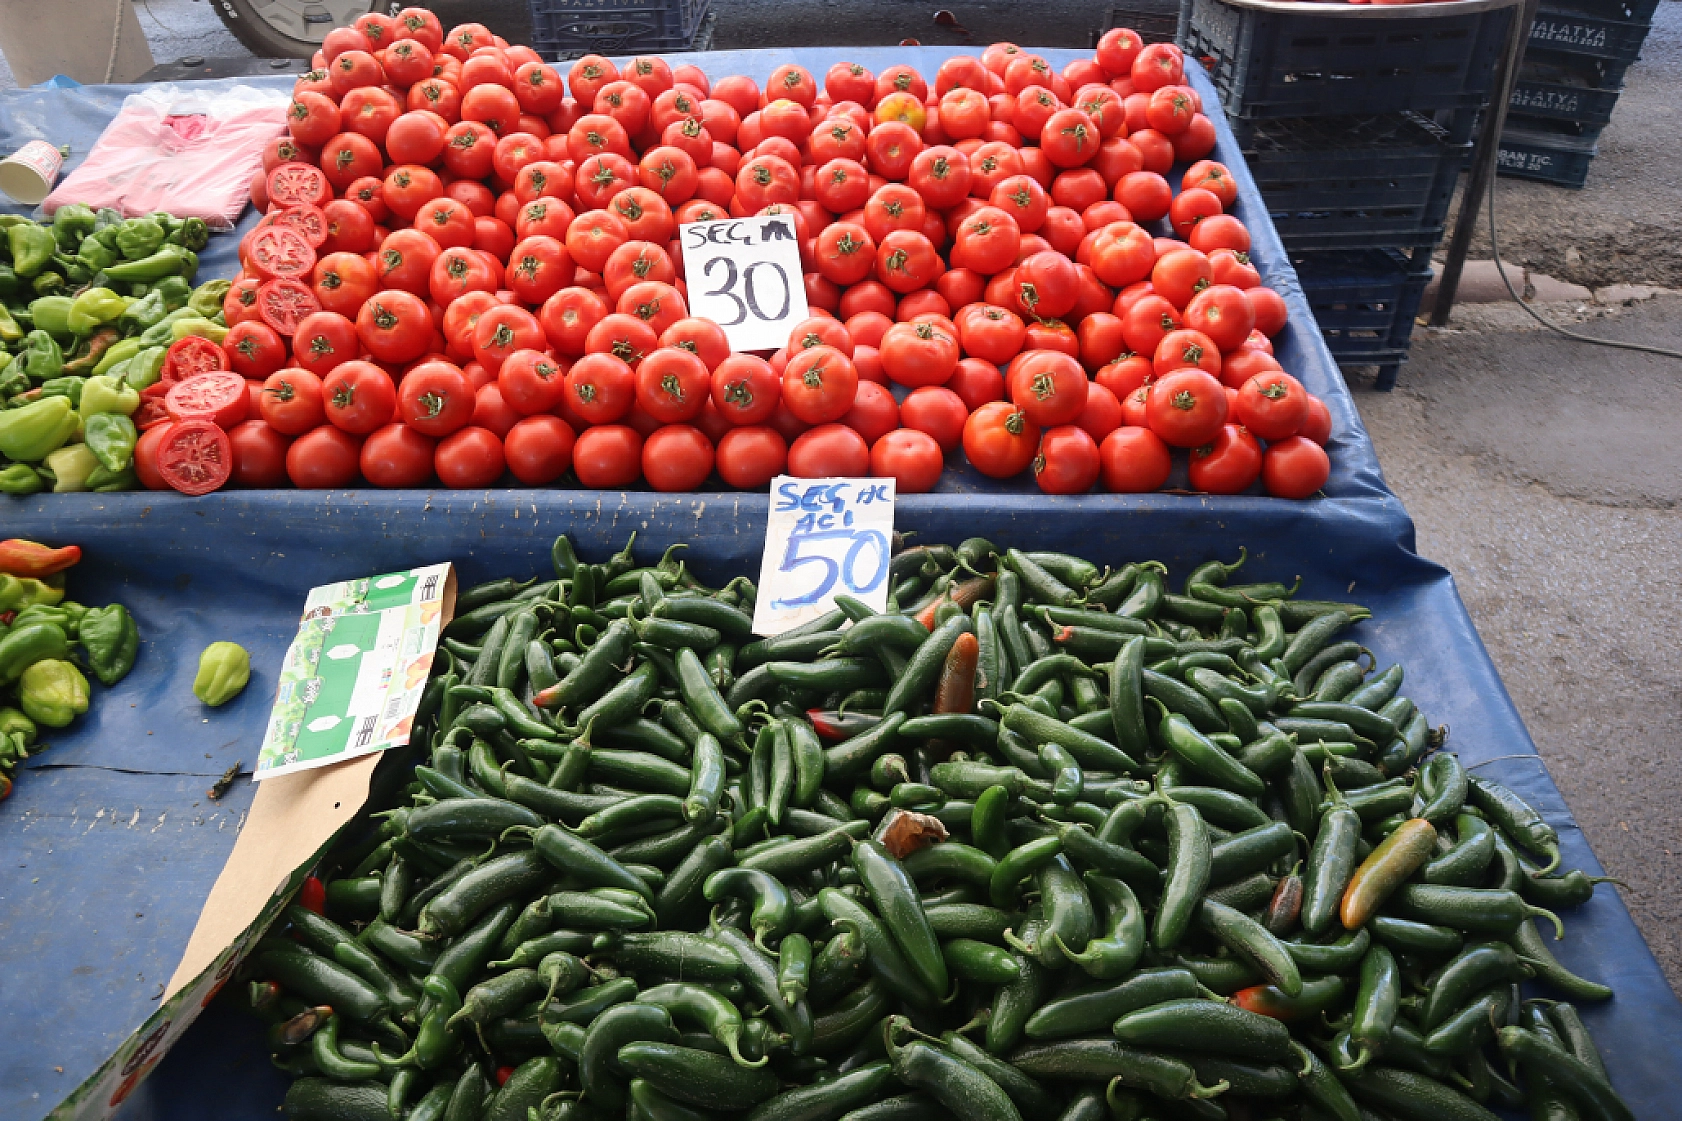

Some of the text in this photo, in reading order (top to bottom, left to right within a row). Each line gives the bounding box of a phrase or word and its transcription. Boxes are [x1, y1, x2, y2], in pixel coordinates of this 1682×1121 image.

[1511, 87, 1578, 106] ALATYA
[703, 256, 790, 326] 30
[769, 528, 890, 610] 50
